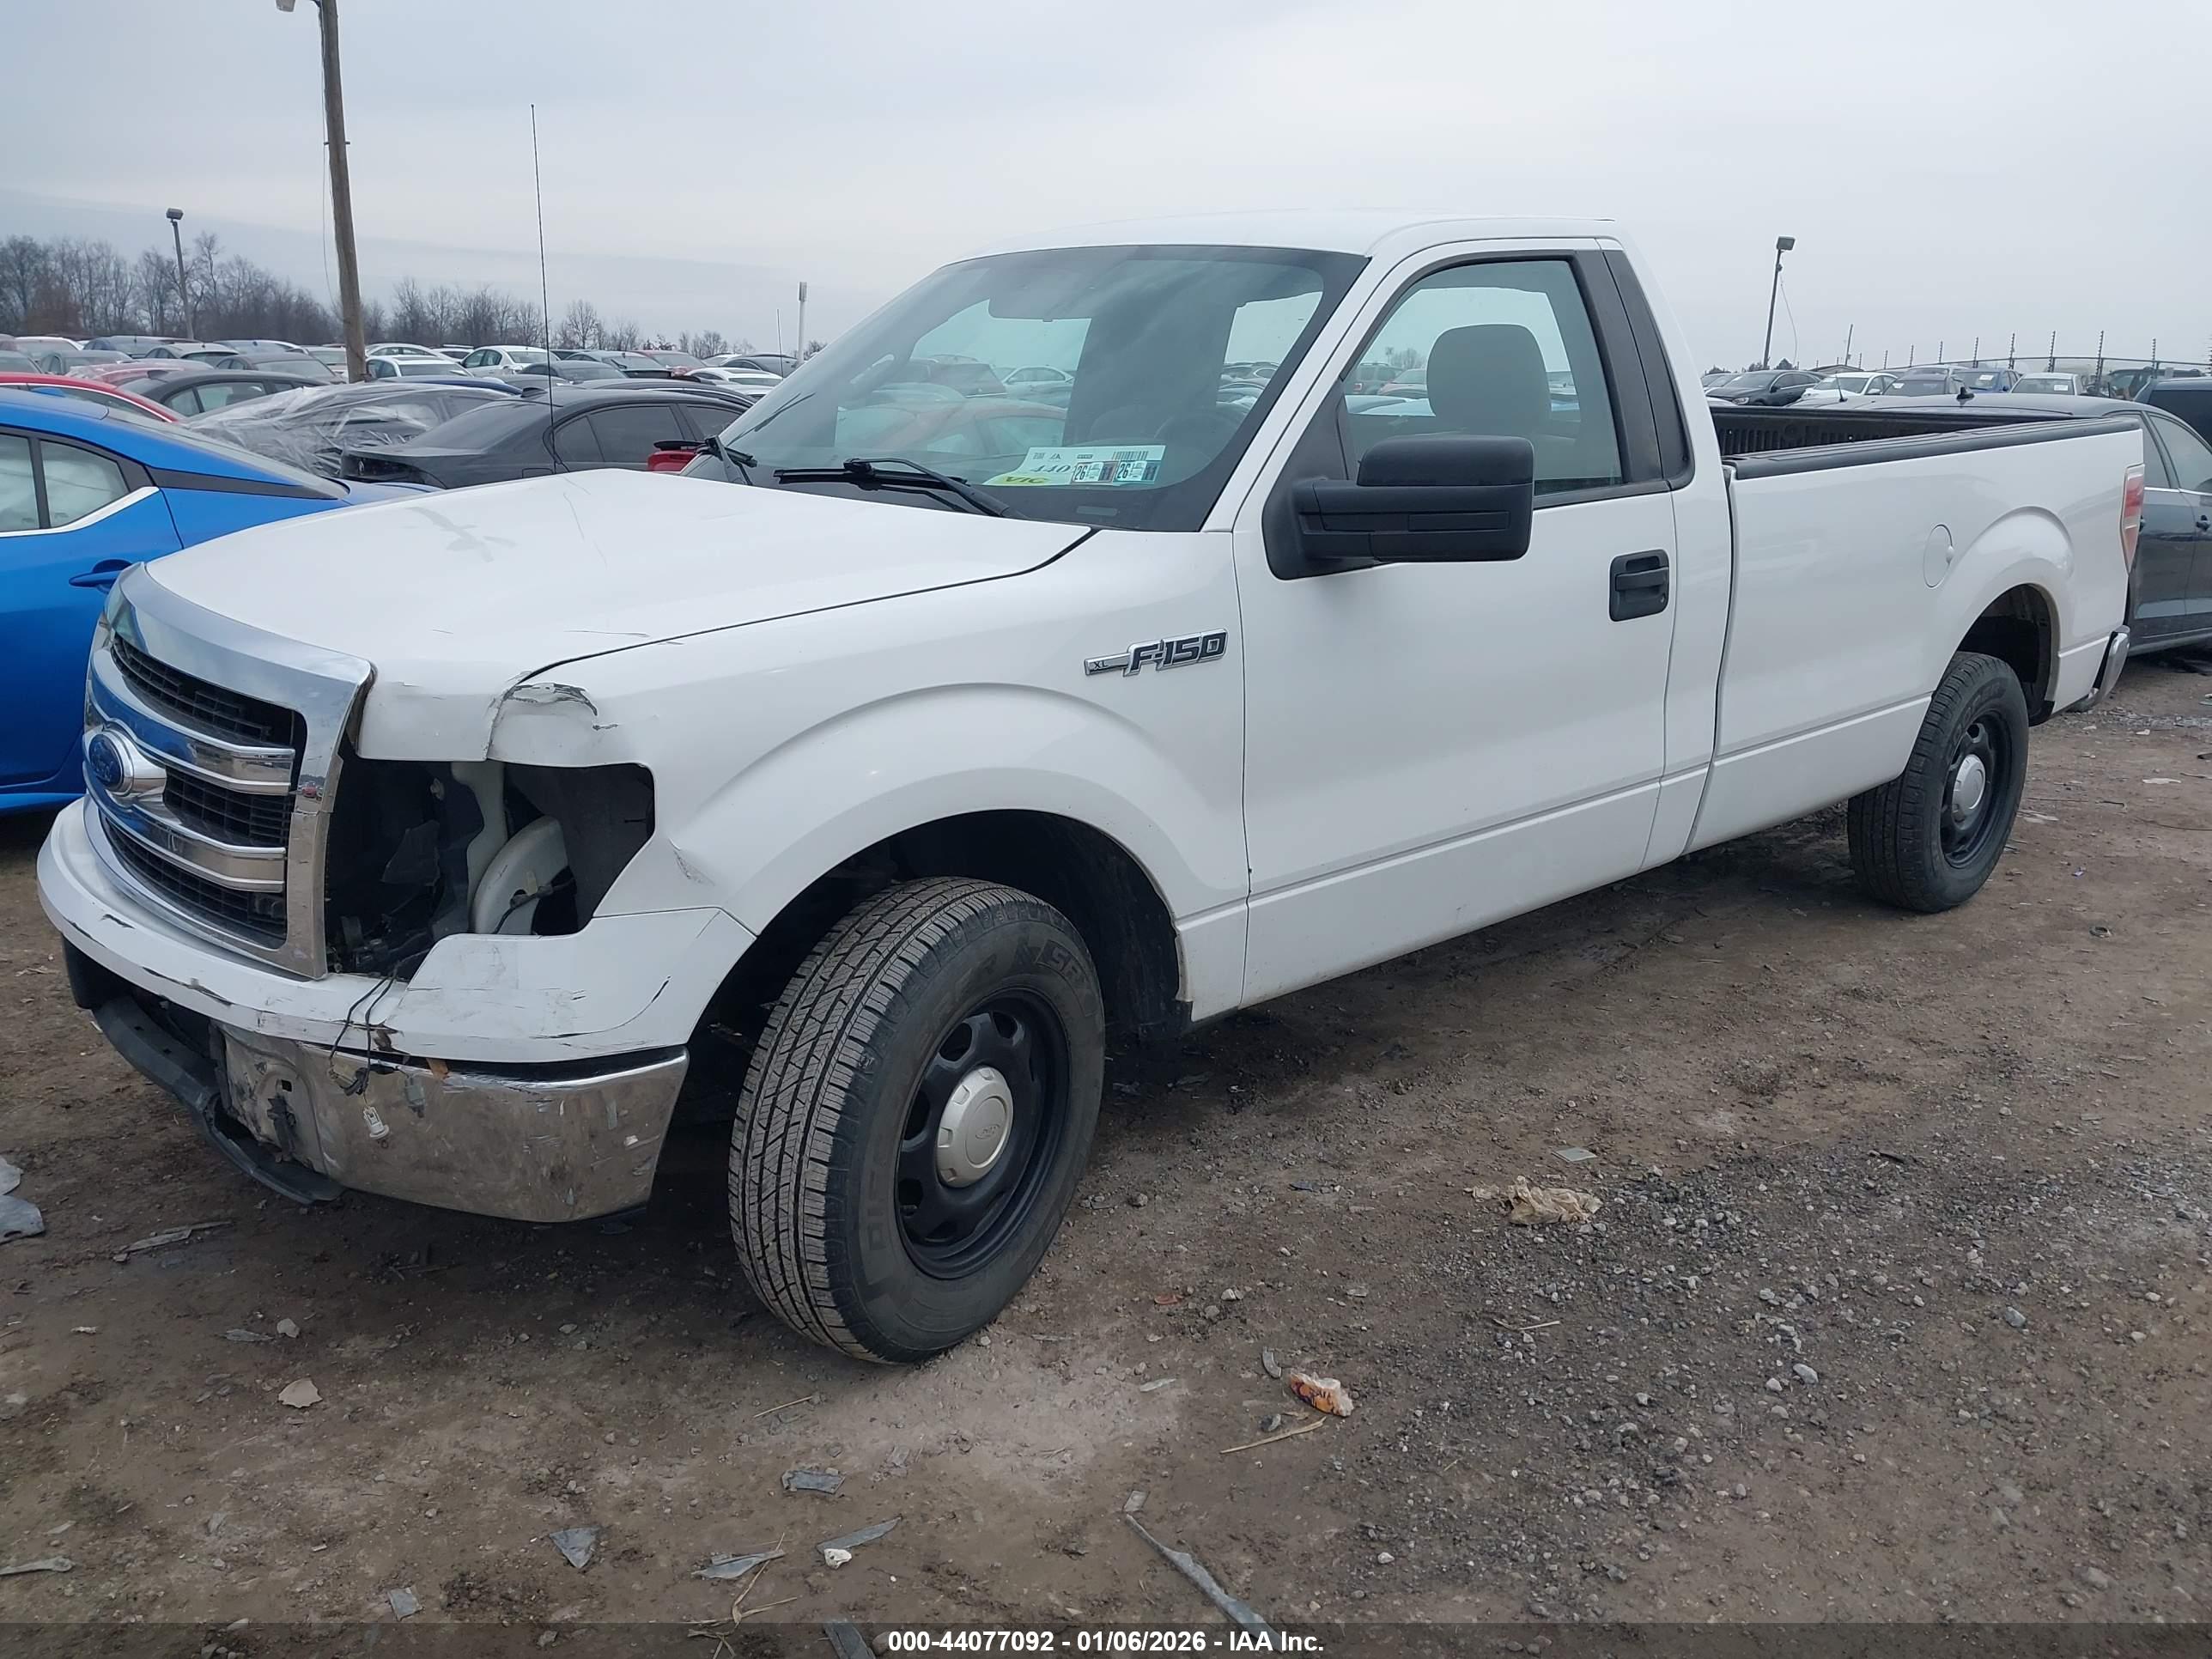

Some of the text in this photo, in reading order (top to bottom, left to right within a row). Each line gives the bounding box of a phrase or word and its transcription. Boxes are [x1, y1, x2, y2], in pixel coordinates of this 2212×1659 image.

[1074, 465, 1087, 480] 26
[1117, 463, 1131, 479] 26
[1093, 629, 1228, 677] XL F-150
